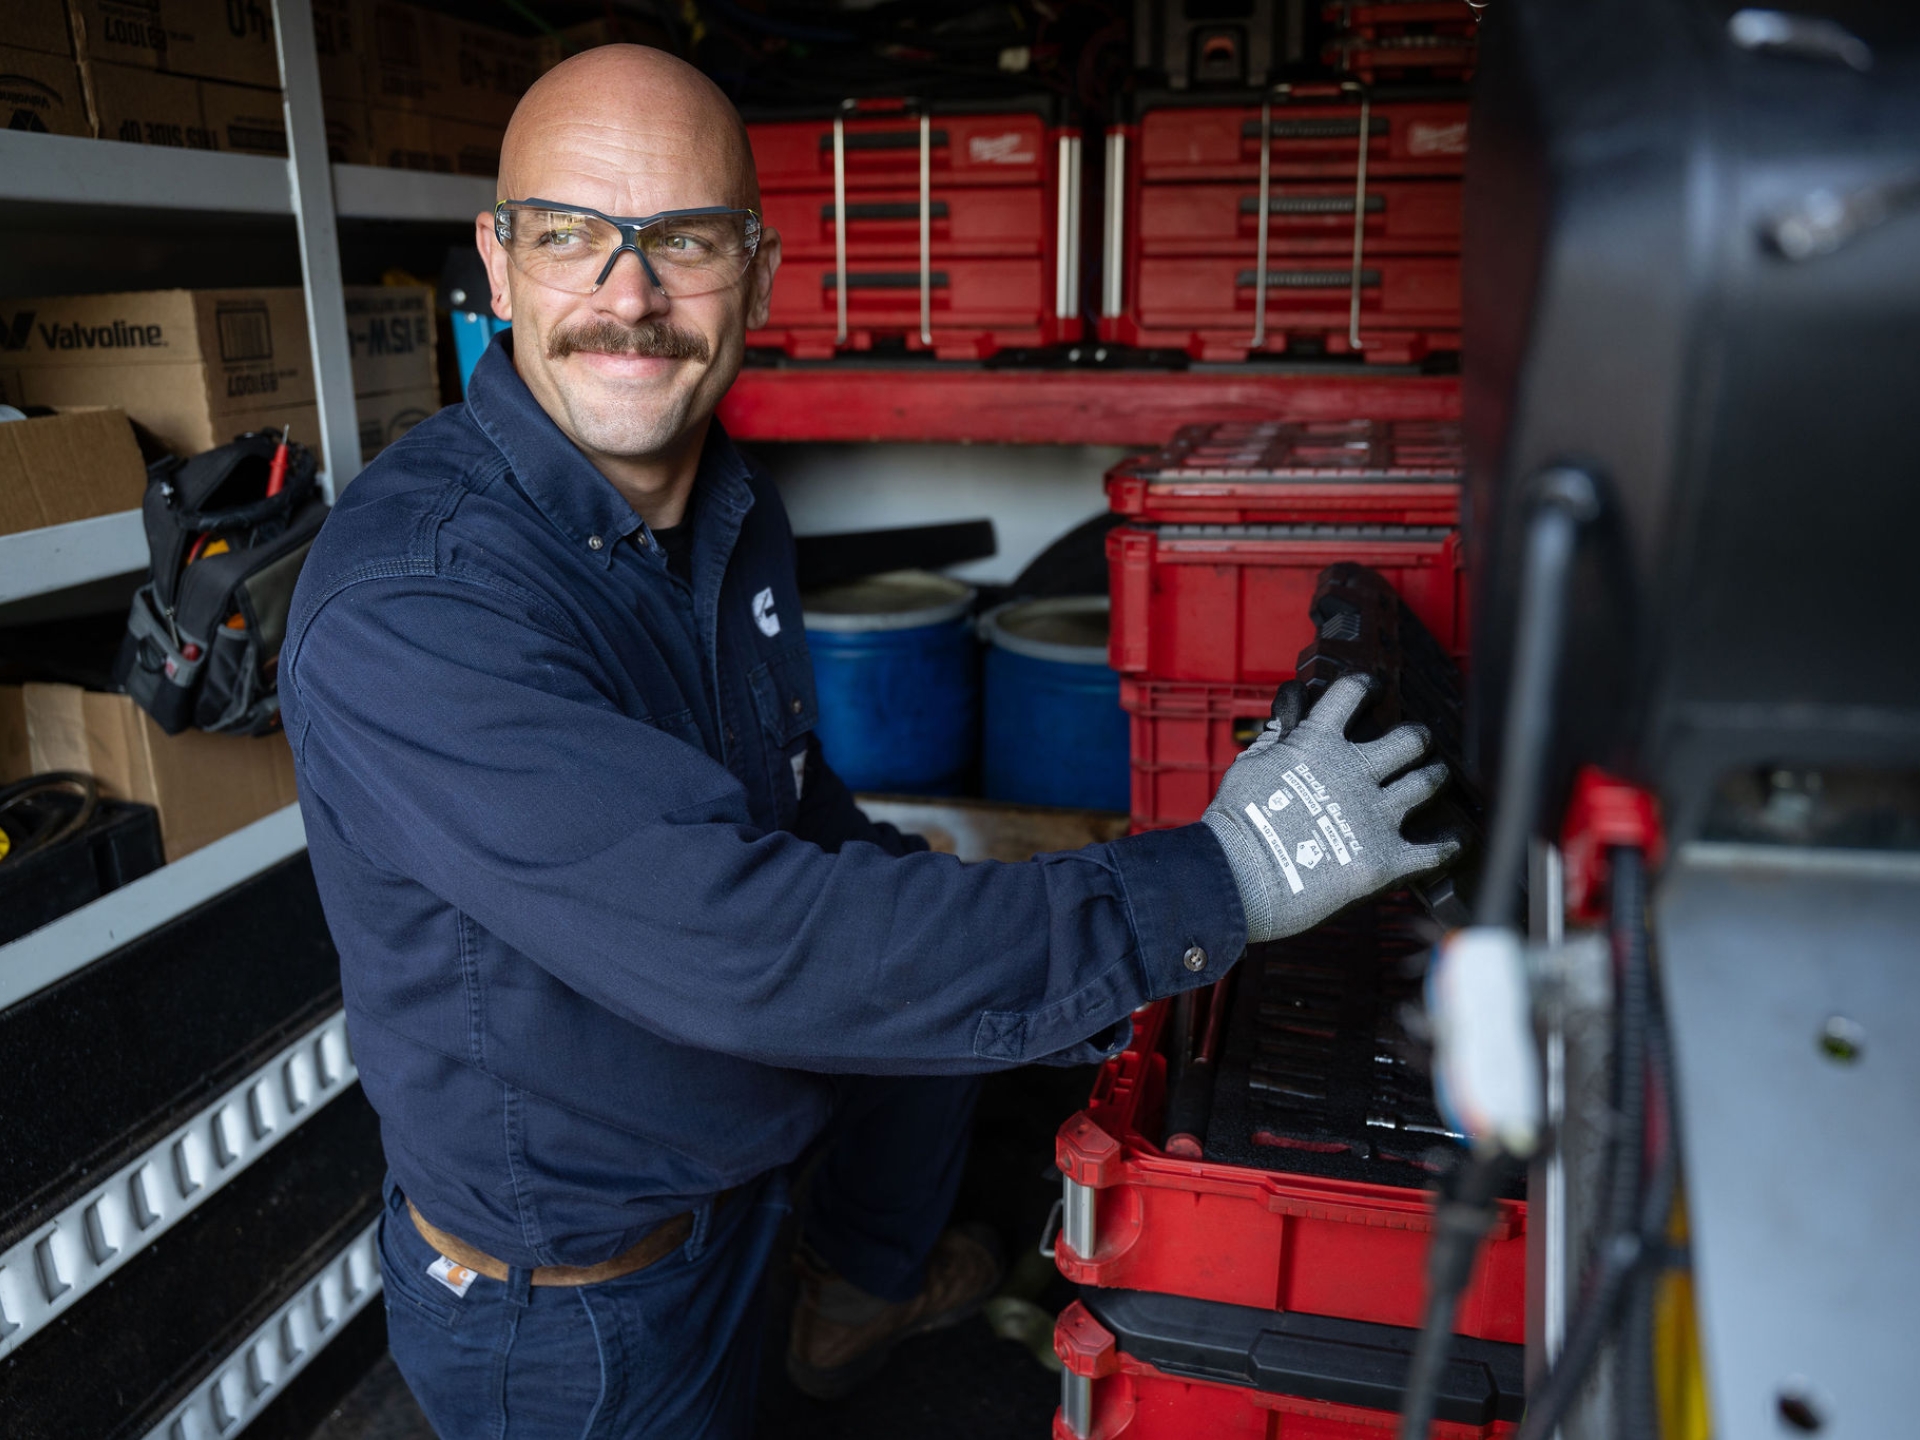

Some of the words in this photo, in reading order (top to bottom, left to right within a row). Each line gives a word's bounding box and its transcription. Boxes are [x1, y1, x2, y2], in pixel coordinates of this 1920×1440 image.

[38, 318, 163, 350] Valvoline
[1295, 763, 1330, 801] Body
[1325, 802, 1363, 853] Guard
